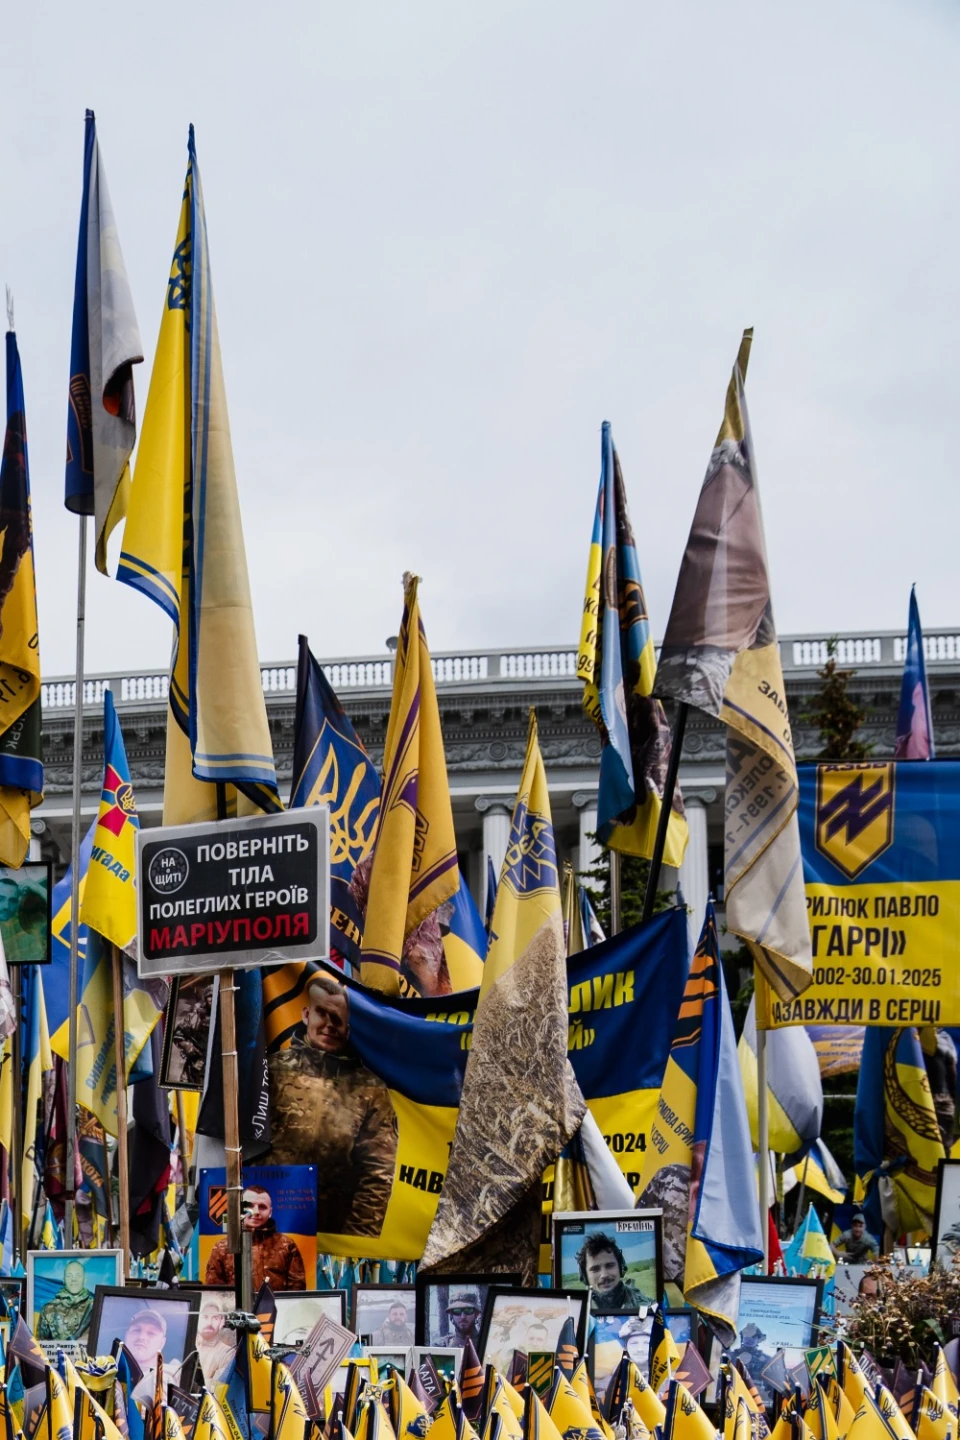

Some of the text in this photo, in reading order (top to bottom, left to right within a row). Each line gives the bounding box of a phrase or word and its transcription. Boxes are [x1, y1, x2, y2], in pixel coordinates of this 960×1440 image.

[197, 834, 309, 863] ПОВЕРНІТЬ
[161, 857, 176, 868] НА
[155, 873, 182, 886] ЩИТІ
[228, 865, 275, 886] ТІЛА
[150, 885, 309, 921] ПОЛЕГЛИХ ГЕРОЇВ
[874, 895, 939, 918] ПАВЛО
[150, 912, 309, 951] МАРІУПОЛЯ
[869, 999, 880, 1019] В
[886, 998, 940, 1022] СЕРЦІ
